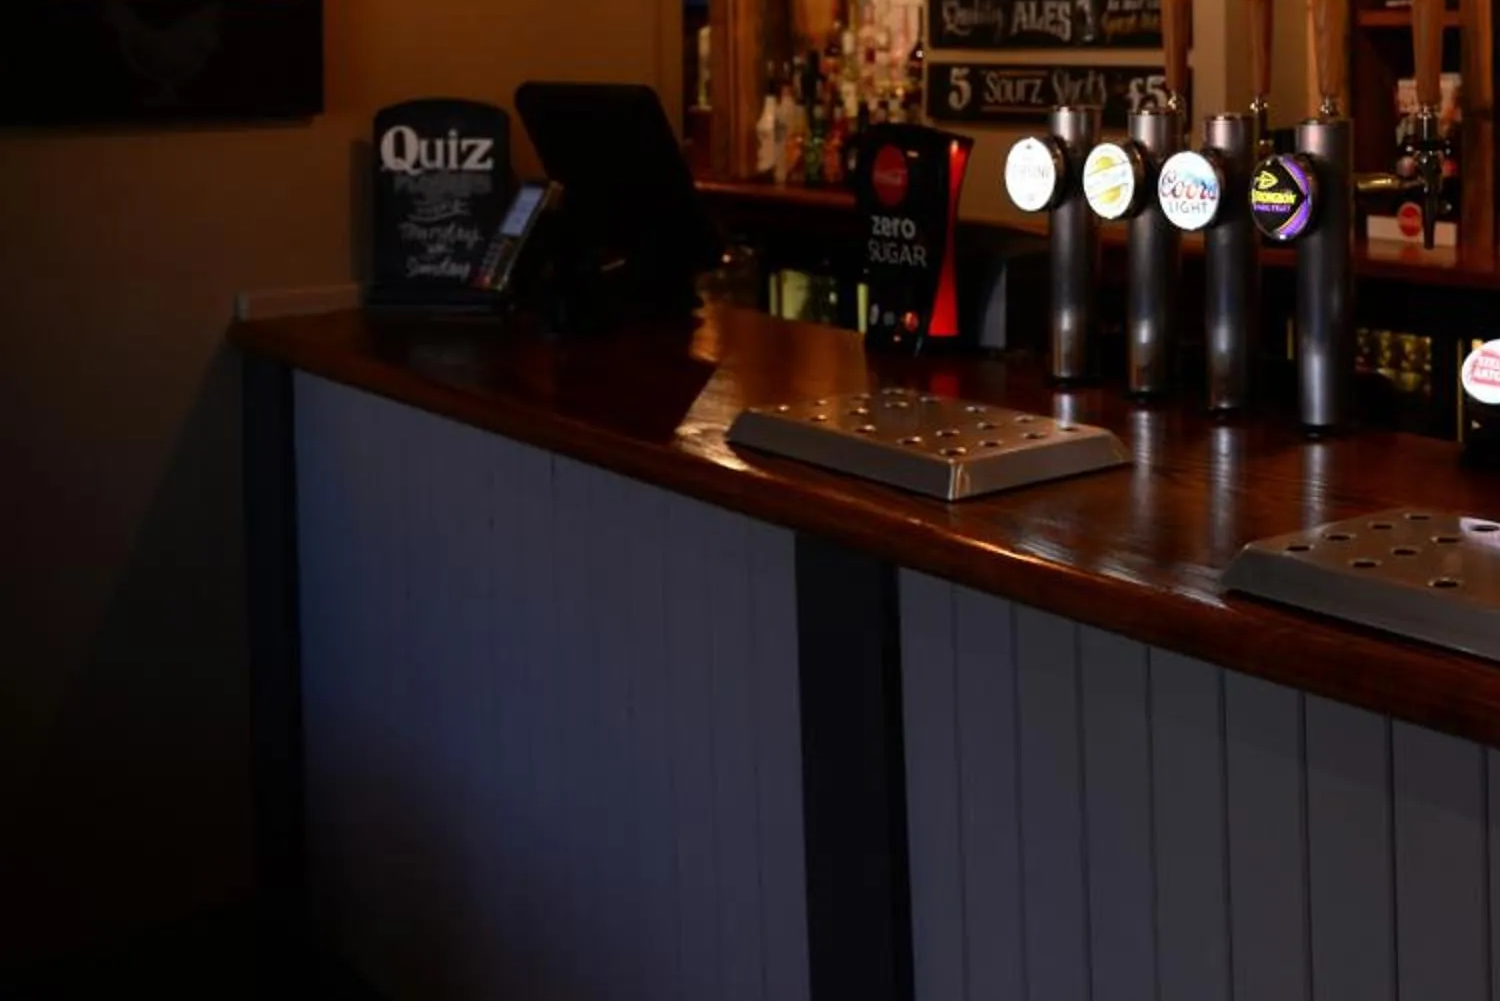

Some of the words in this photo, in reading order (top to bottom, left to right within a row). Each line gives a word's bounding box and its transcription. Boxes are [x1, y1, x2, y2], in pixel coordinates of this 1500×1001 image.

[947, 66, 973, 111] 5
[379, 124, 495, 176] Quiz
[1167, 202, 1209, 214] LIGHT
[867, 237, 929, 269] SUGAR
